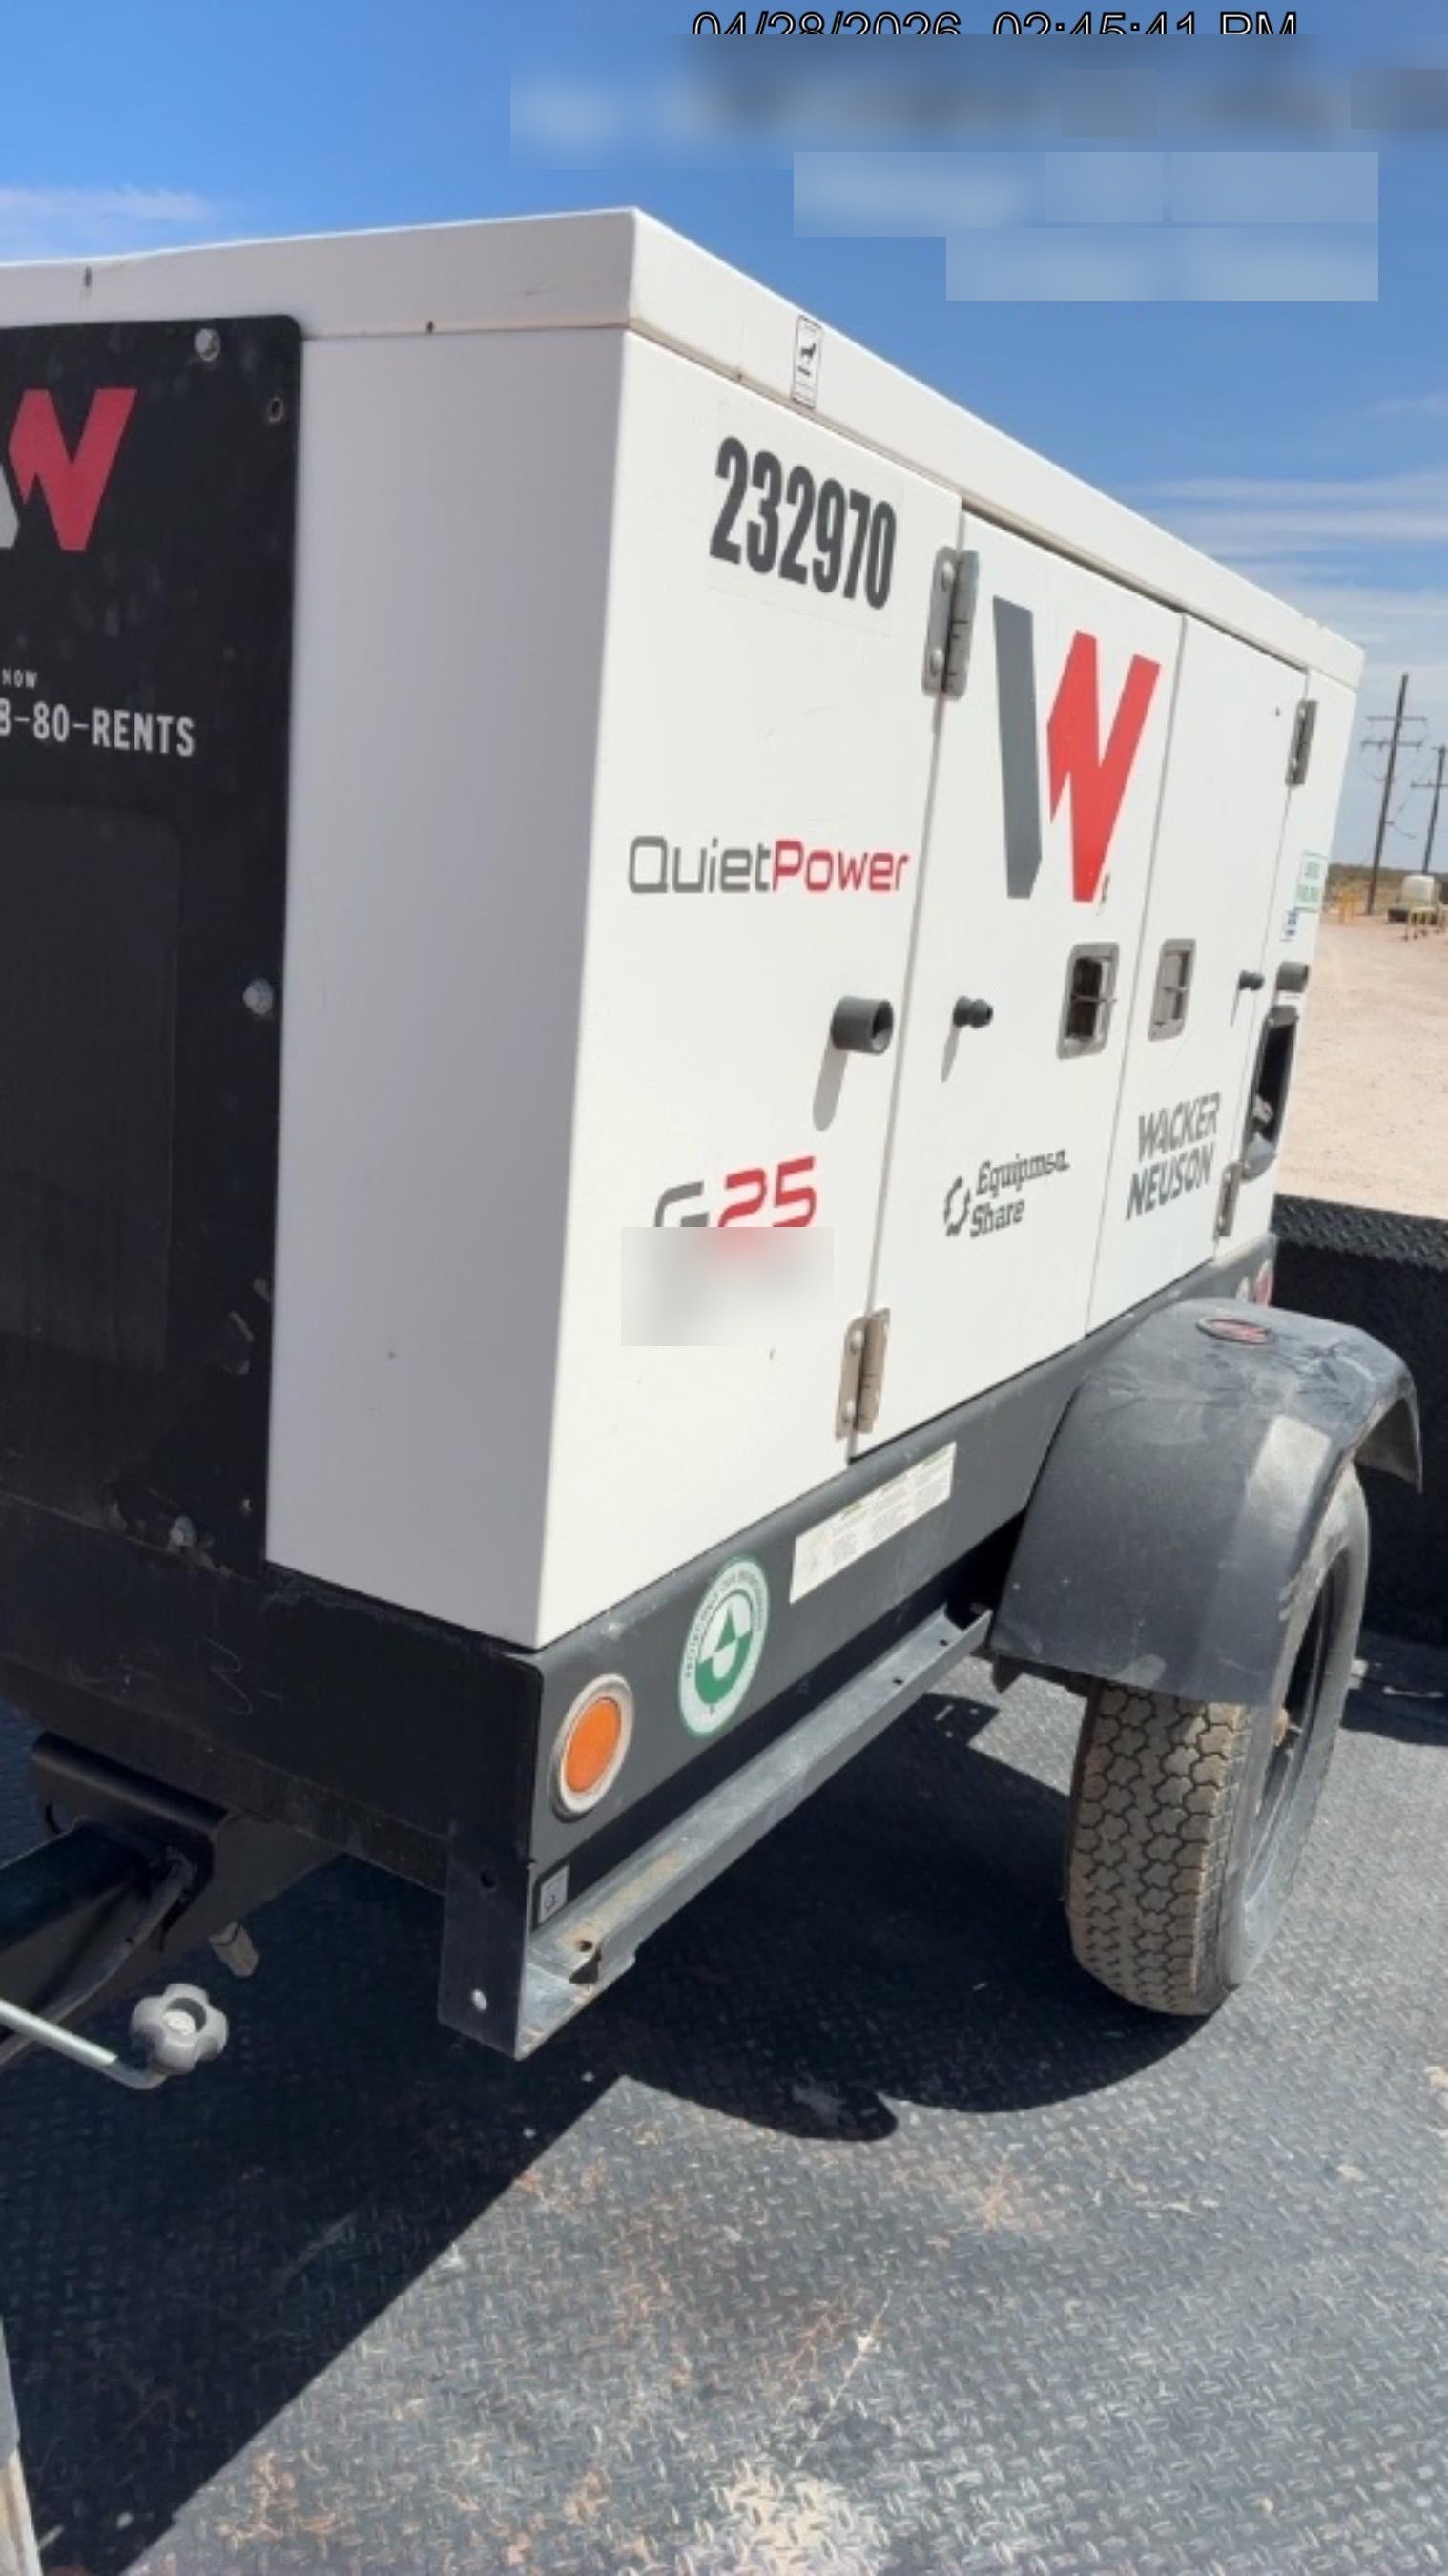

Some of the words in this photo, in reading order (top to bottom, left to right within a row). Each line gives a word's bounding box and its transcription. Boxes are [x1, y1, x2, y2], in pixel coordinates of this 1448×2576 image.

[709, 436, 898, 610] 232970
[2, 669, 38, 689] NOW
[628, 836, 910, 895] QuietPower
[1138, 1092, 1220, 1163] WACKER
[654, 1155, 817, 1227] G25
[1126, 1143, 1213, 1221] NEUSON
[970, 1199, 1025, 1239] Share
